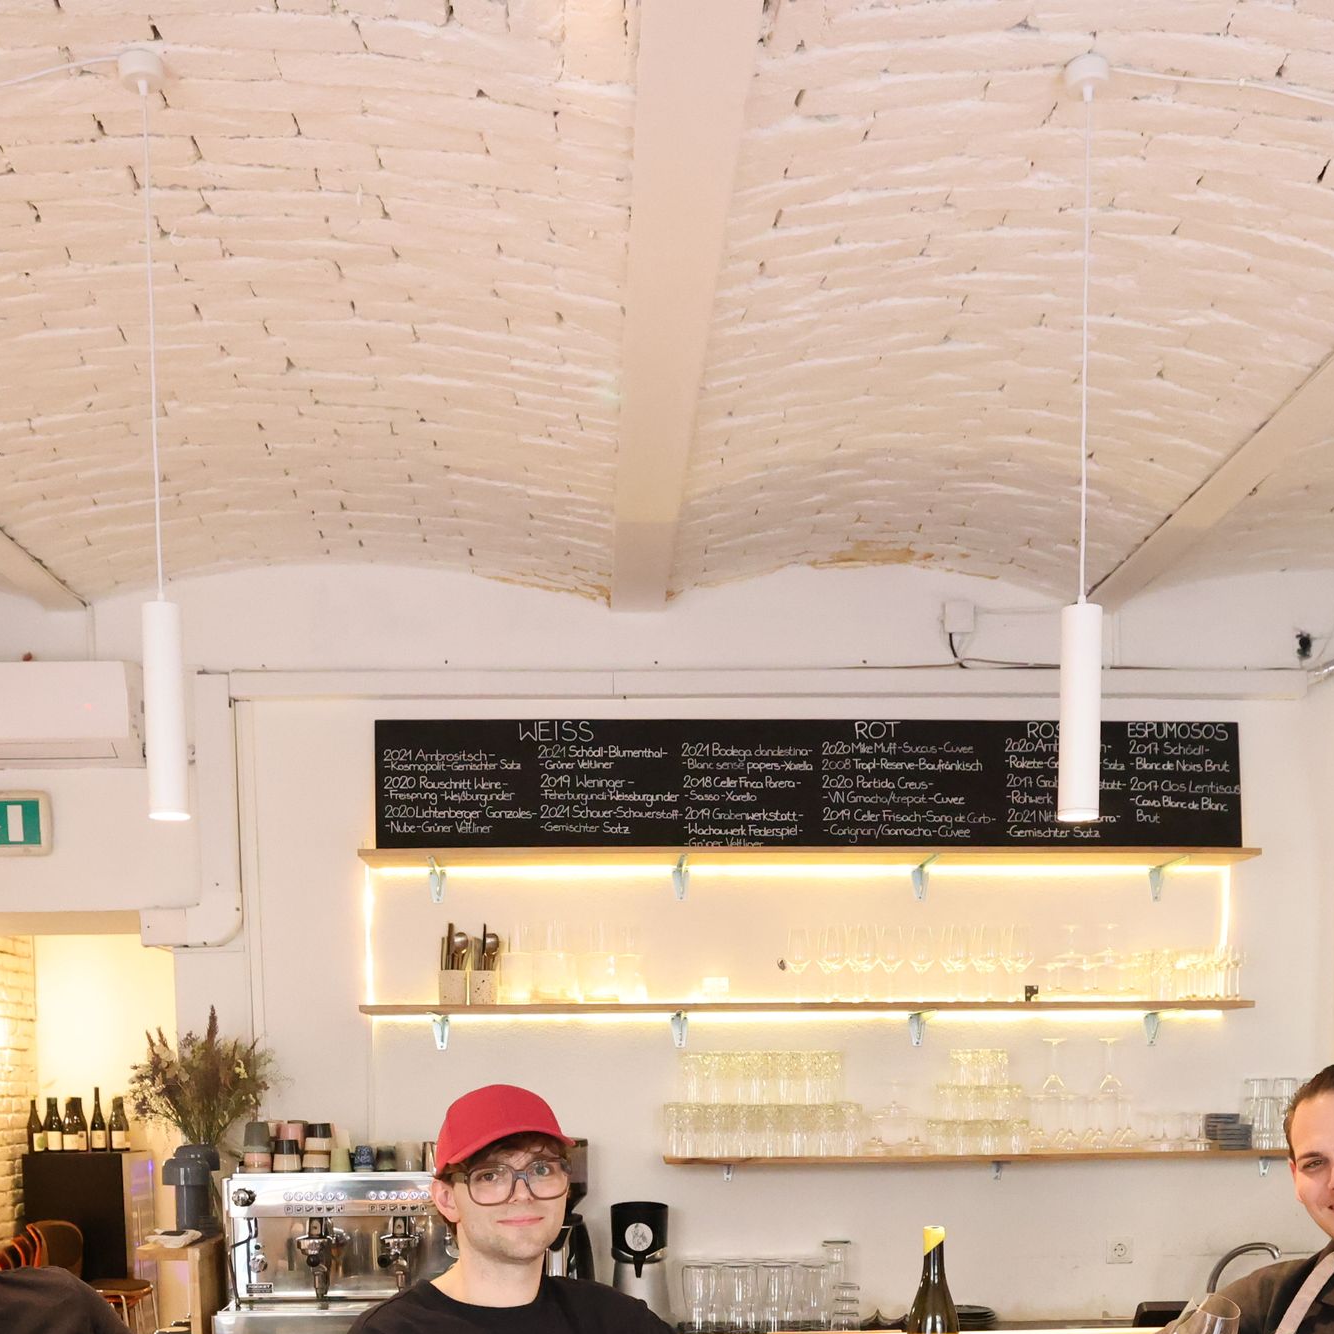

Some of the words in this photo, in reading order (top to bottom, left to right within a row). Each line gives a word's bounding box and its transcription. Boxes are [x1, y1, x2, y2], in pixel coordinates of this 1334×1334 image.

[519, 721, 594, 742] WEISS
[855, 721, 901, 739] ROT
[1027, 721, 1059, 739] RO
[1127, 723, 1228, 741] ESPUMOSOS
[538, 744, 565, 759] 2021
[681, 742, 709, 757] 2021
[712, 742, 752, 762] Bodega
[822, 741, 851, 755] 2020
[1005, 738, 1034, 752] 2020
[1129, 740, 1159, 755] 2017
[383, 749, 412, 762] 2021
[499, 759, 522, 771] Satz
[822, 758, 851, 771] 2008
[1204, 758, 1230, 773] Brut
[383, 775, 416, 789] 2020
[540, 773, 570, 788] 2019
[683, 775, 712, 789] 2018
[713, 777, 738, 788] Celler
[738, 777, 764, 789] Finca
[822, 775, 853, 789] 2020
[1006, 773, 1033, 788] 2017
[1130, 777, 1159, 791] 2017
[1161, 780, 1187, 792] Clos
[1162, 795, 1187, 809] Blanc
[1201, 797, 1229, 812] Blanc
[384, 805, 416, 819] 2020
[540, 805, 570, 819] 2021
[685, 806, 711, 820] 2019
[823, 807, 851, 821] 2019
[854, 809, 881, 822] Celler
[1007, 808, 1036, 823] 2021
[1136, 809, 1161, 824] Brut
[603, 822, 631, 834] Satz
[1074, 826, 1101, 838] Satz
